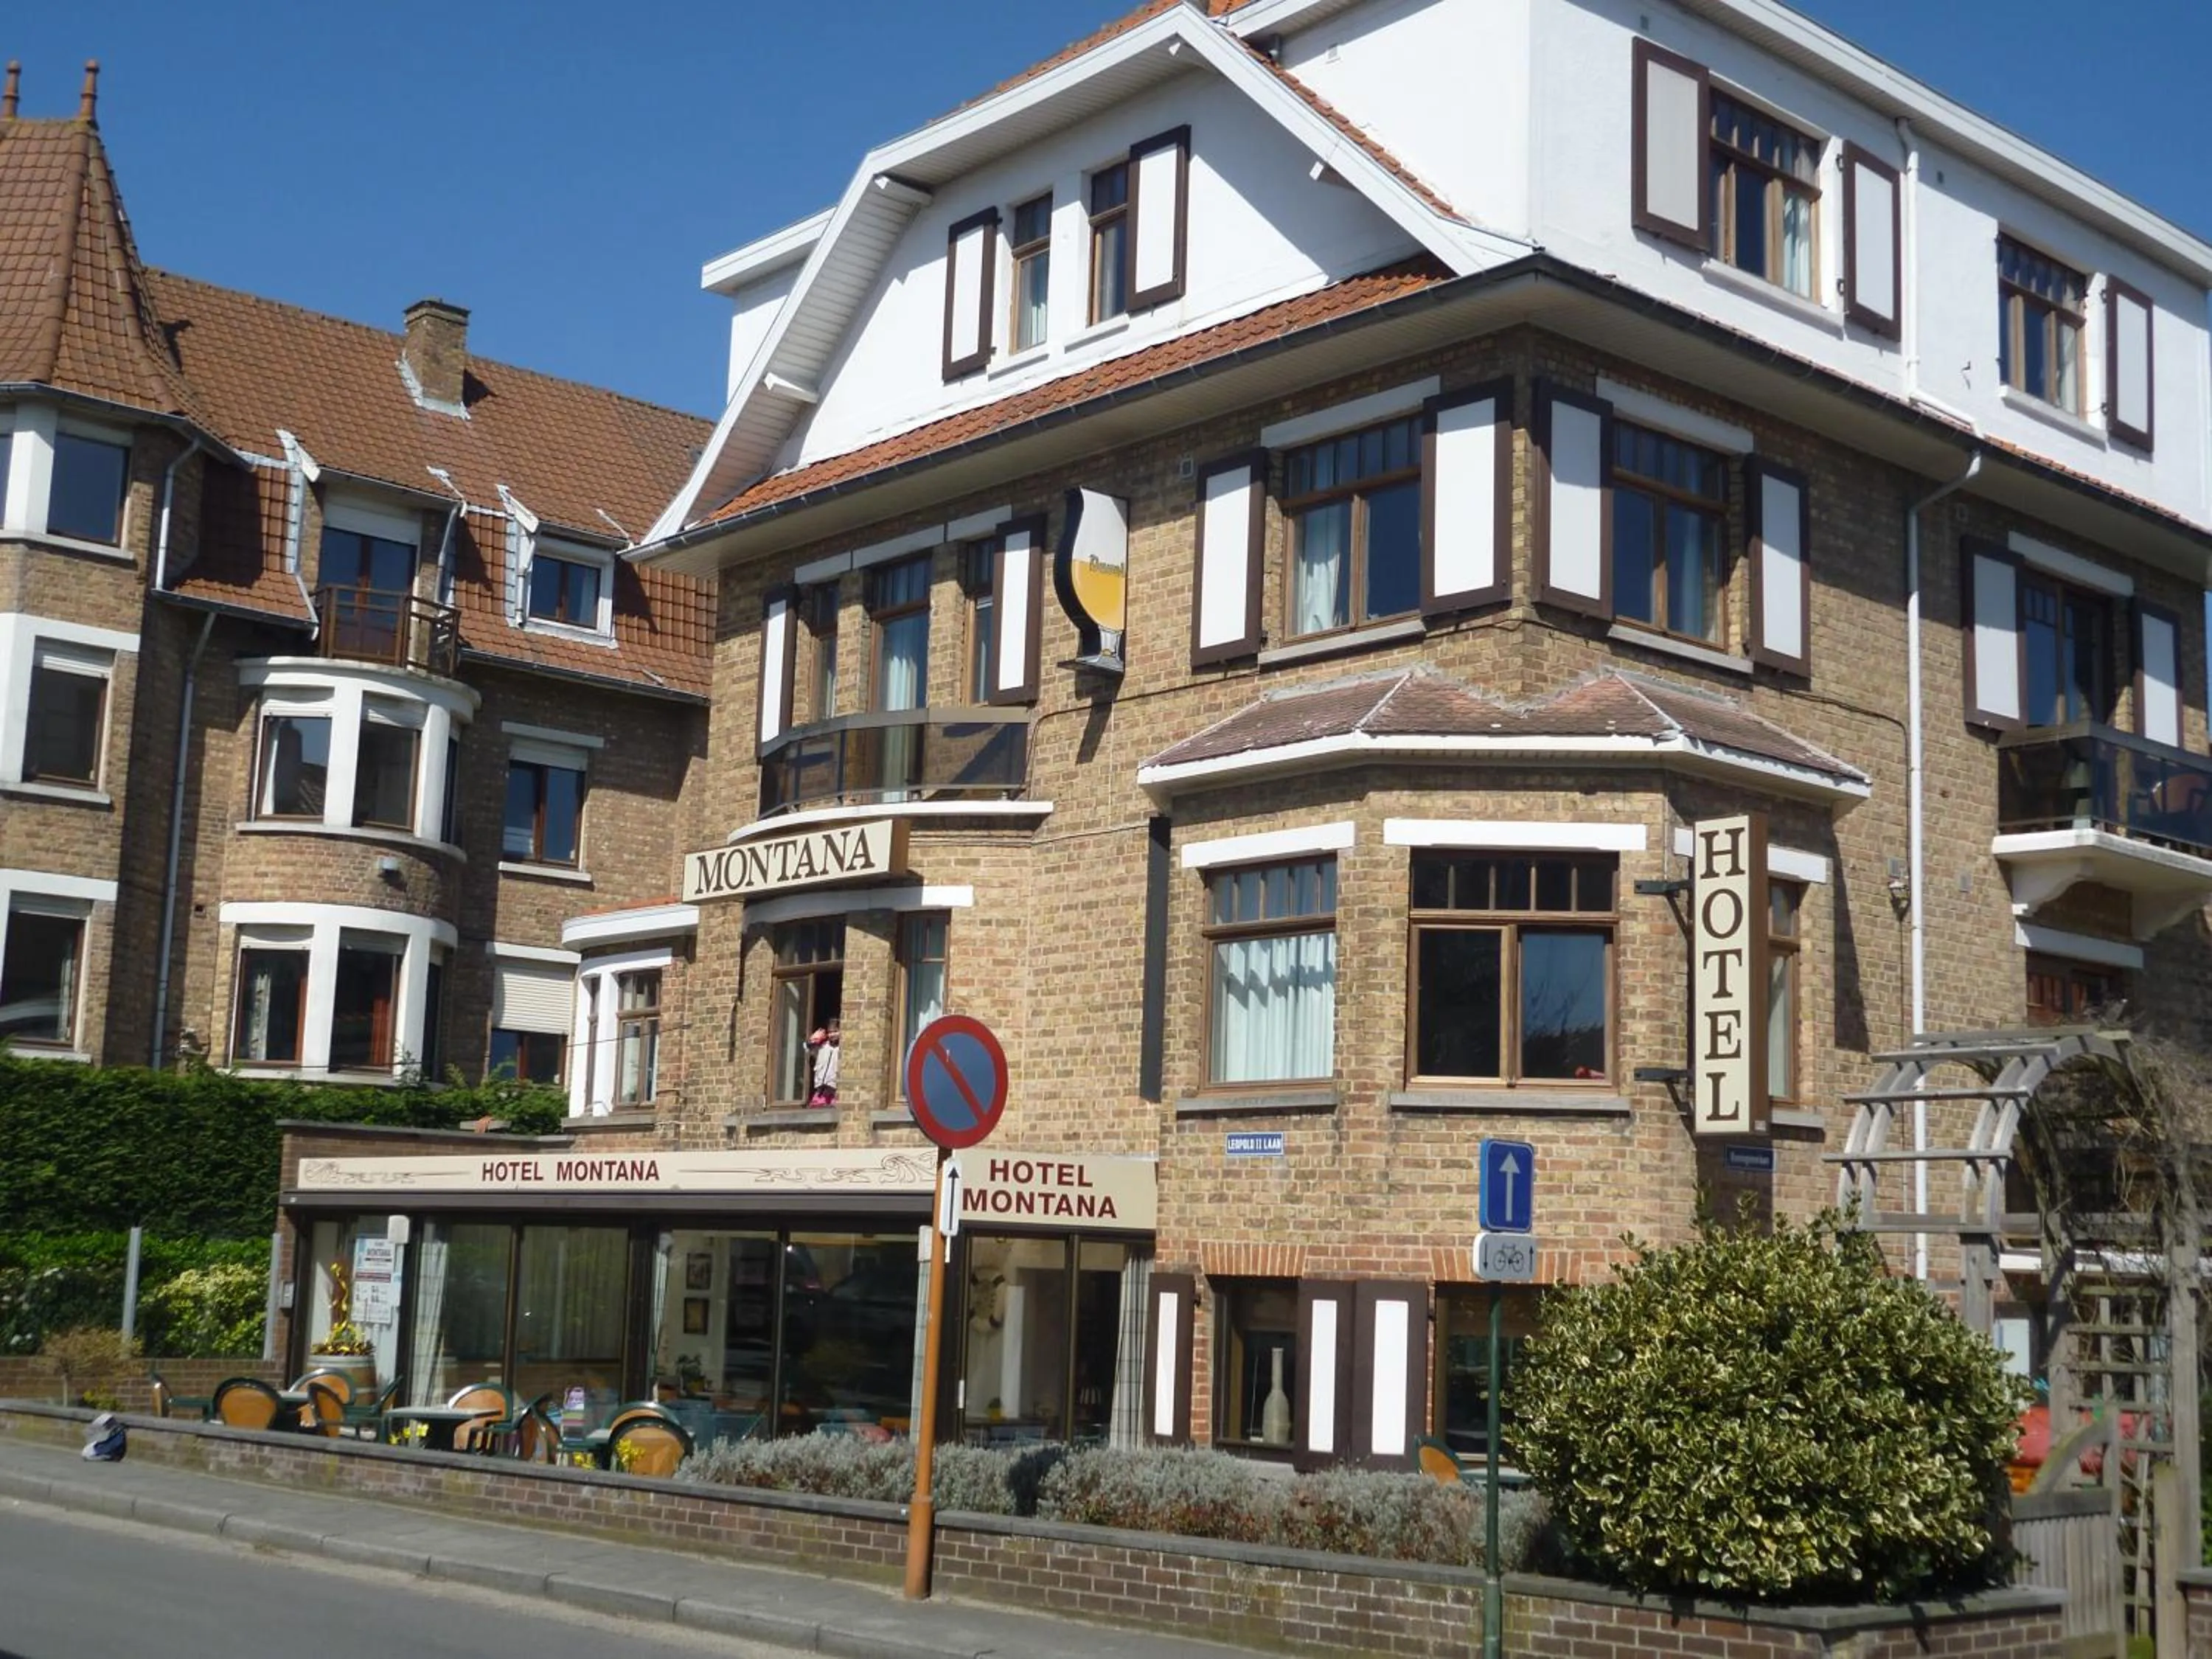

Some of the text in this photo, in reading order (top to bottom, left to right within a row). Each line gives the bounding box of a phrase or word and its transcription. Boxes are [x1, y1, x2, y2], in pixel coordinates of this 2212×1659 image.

[695, 828, 875, 894] MONTANA
[1699, 827, 1746, 1121] HOTEL
[482, 1160, 660, 1181] HOTEL MONTANA
[990, 1159, 1093, 1187] HOTEL
[962, 1188, 1117, 1218] MONTANA
